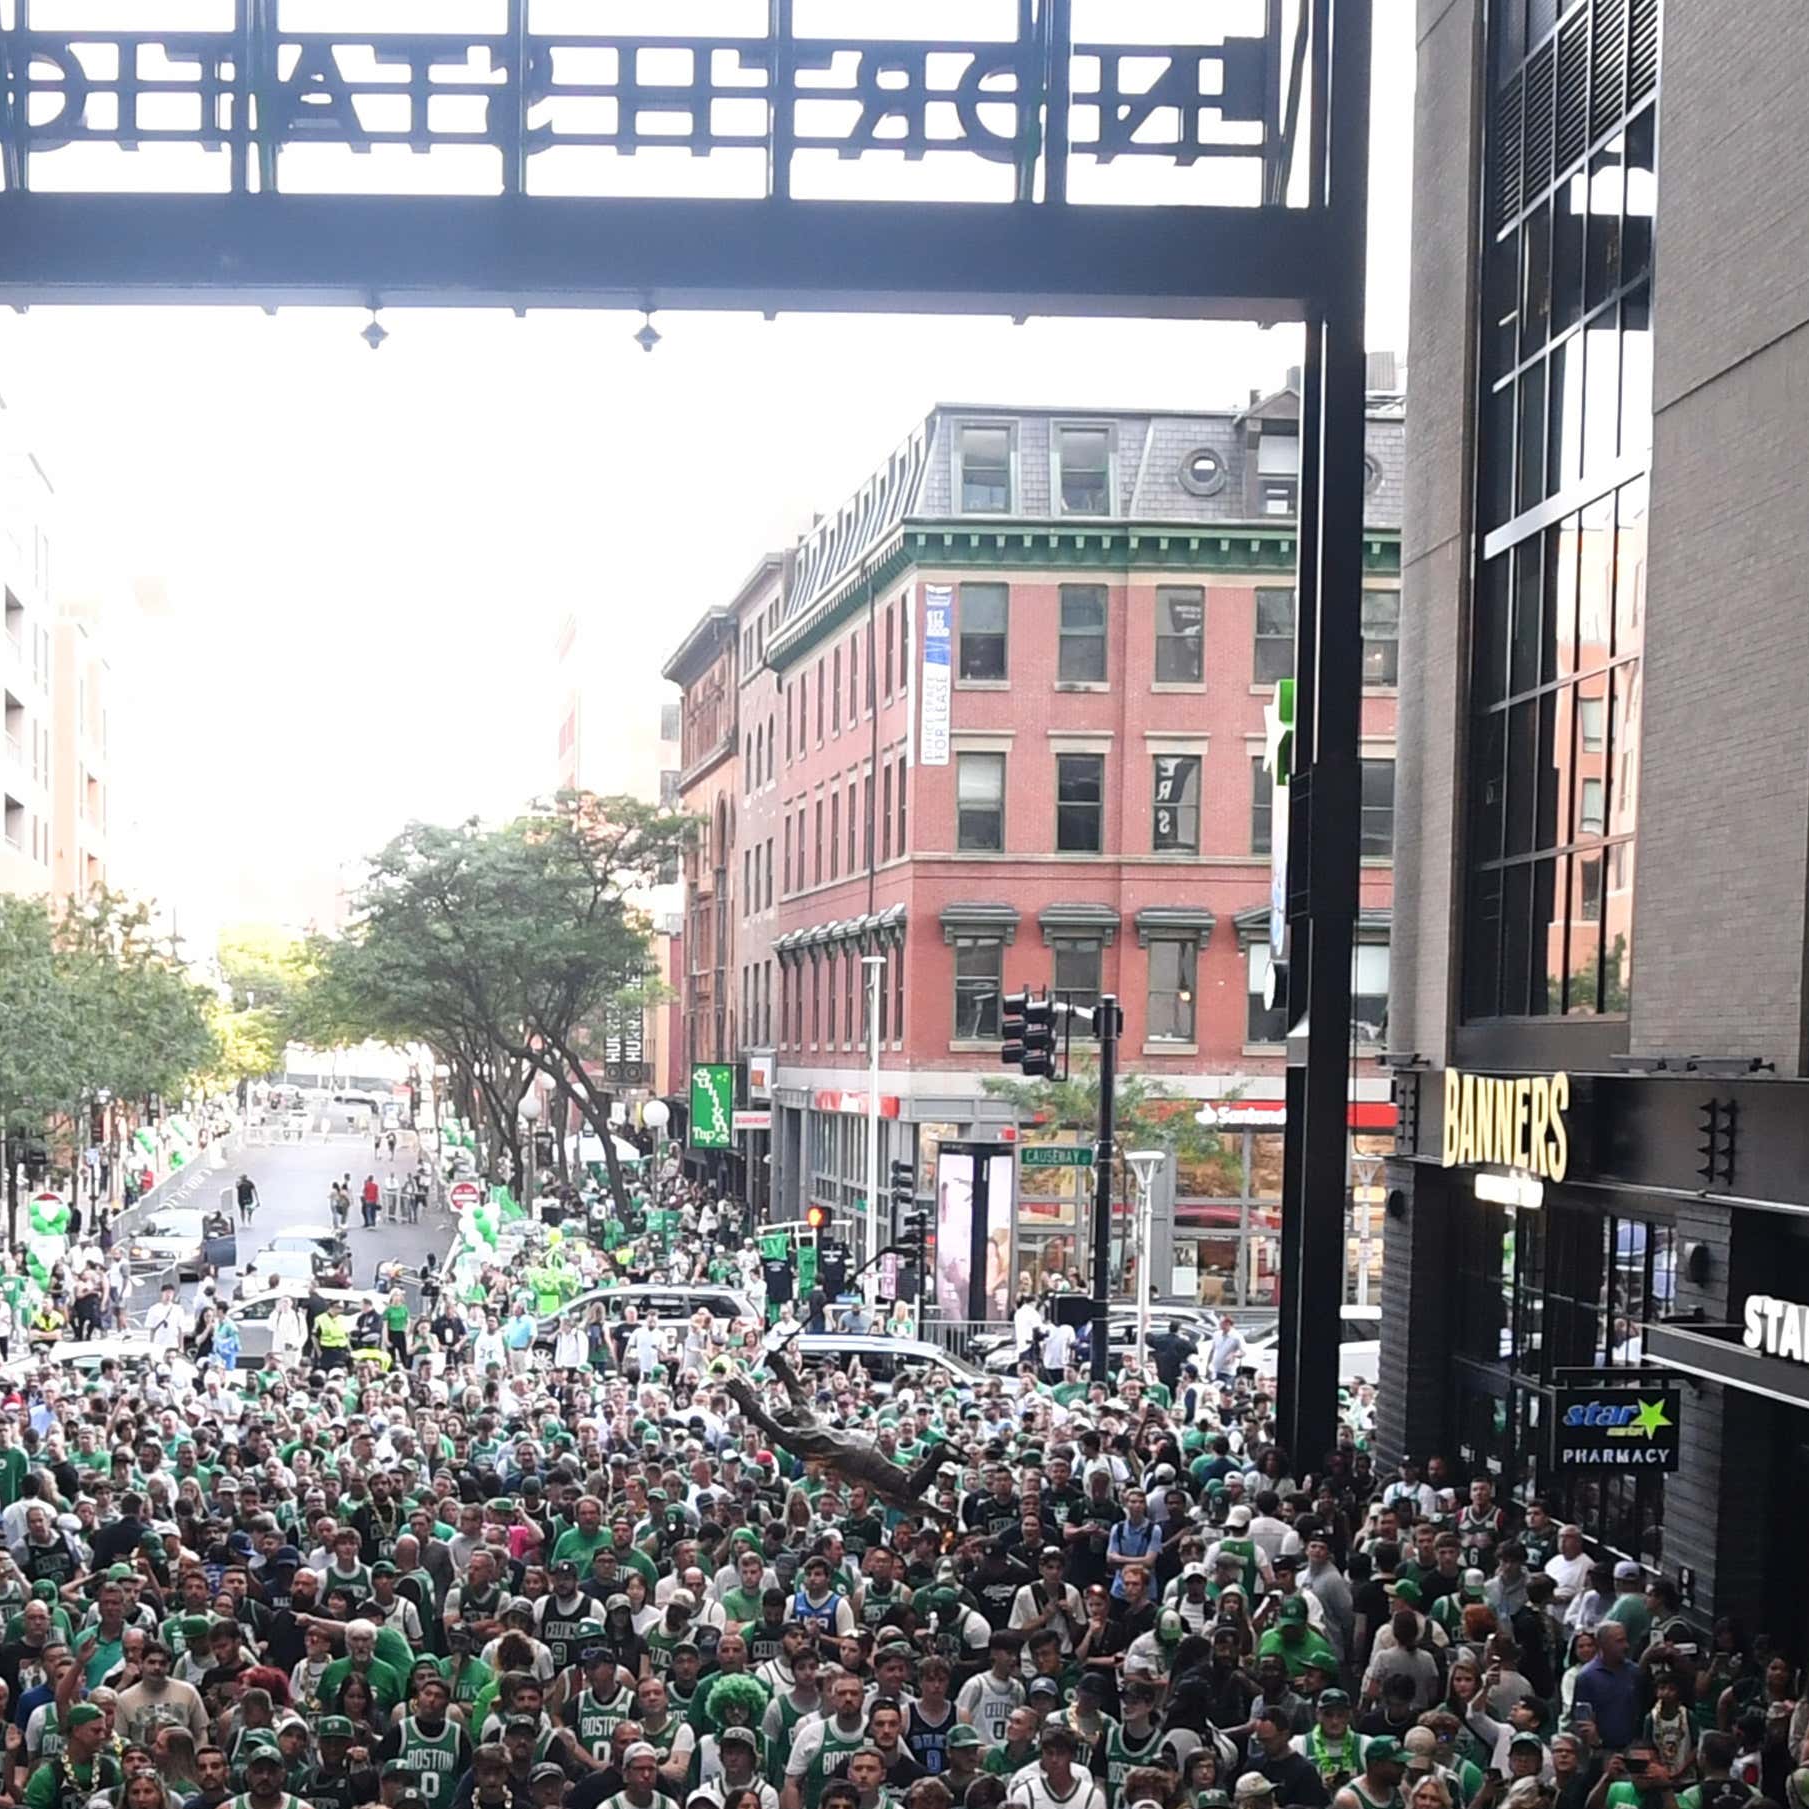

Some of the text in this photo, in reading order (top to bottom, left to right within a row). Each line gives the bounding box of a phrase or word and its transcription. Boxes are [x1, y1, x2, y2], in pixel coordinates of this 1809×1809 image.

[935, 676, 948, 761] FOR LEASE
[1442, 1067, 1569, 1183] BANNERS
[1026, 1149, 1080, 1164] CAUSEWAY
[1563, 1401, 1639, 1426] star
[1563, 1449, 1670, 1463] PHARMACY
[408, 1749, 455, 1771] BOSTON
[421, 1772, 439, 1798] 0
